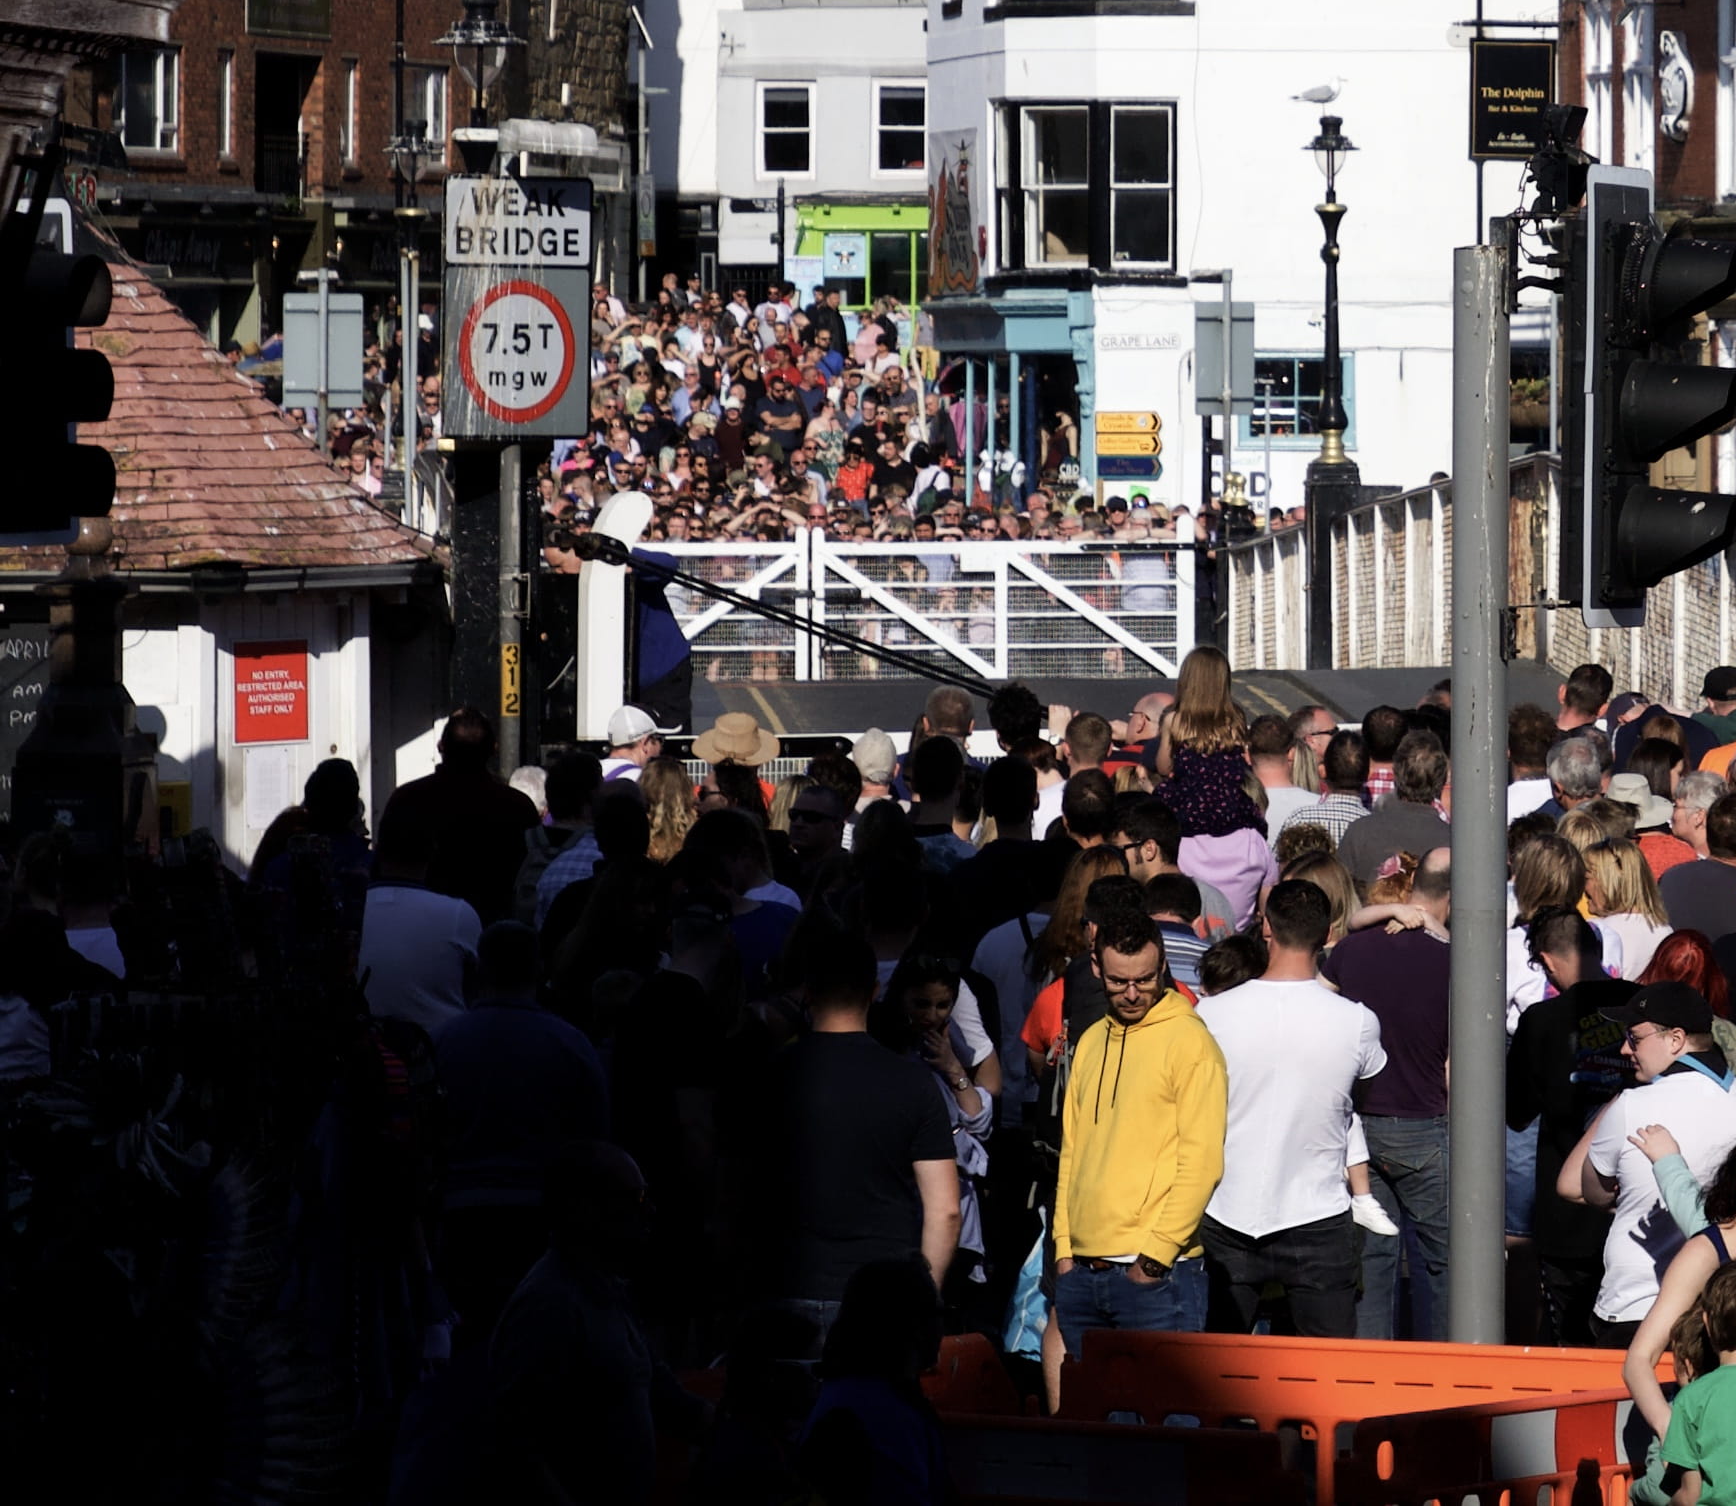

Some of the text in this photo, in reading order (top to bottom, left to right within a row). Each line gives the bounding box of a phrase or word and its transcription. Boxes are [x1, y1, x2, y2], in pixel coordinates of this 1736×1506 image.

[1480, 86, 1545, 102] The Dolphin
[471, 186, 566, 217] WEAK
[455, 226, 580, 257] BRIDGE
[1100, 335, 1177, 348] GRAPE LANE
[1211, 470, 1272, 497] CD
[252, 671, 264, 680] NO
[505, 645, 519, 714] 312
[237, 681, 282, 692] RESTRICTED
[248, 692, 295, 703] AUTHORISED
[249, 703, 294, 715] STAFF ONLY
